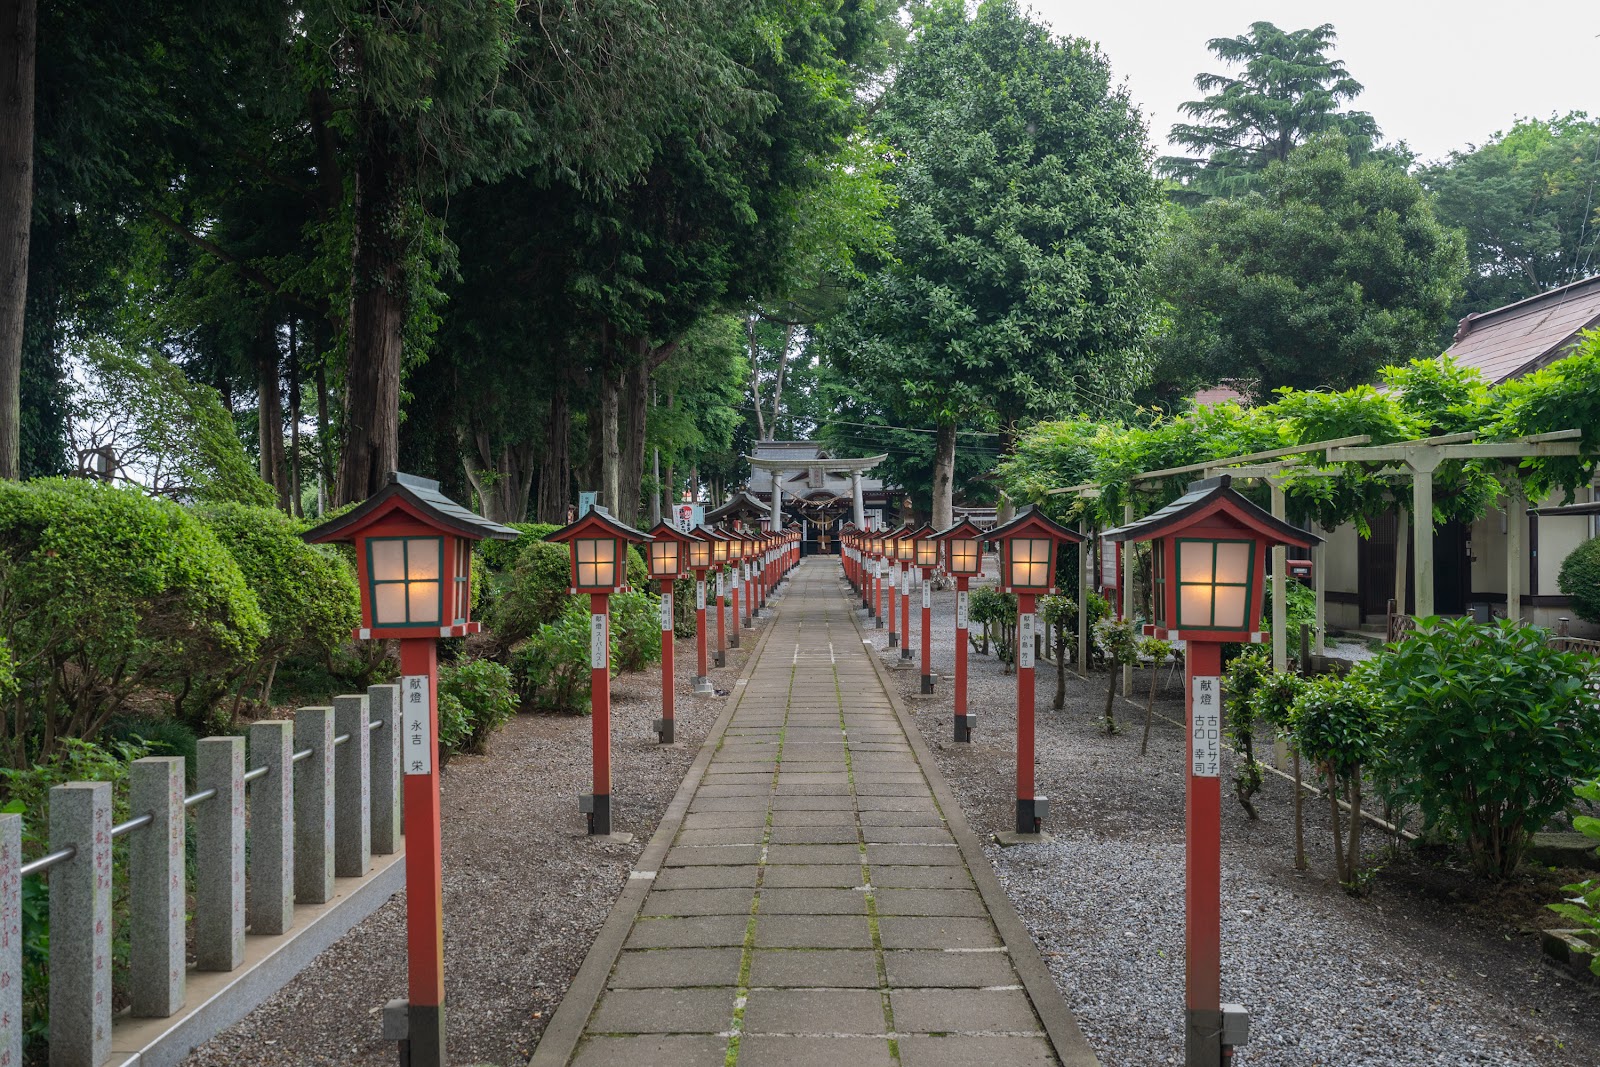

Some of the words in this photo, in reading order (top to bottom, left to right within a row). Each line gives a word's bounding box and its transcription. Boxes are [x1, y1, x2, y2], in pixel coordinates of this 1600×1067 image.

[409, 678, 422, 704] 献燈
[1200, 679, 1212, 705] 献燈
[1207, 714, 1218, 774] 古口ヒサ子
